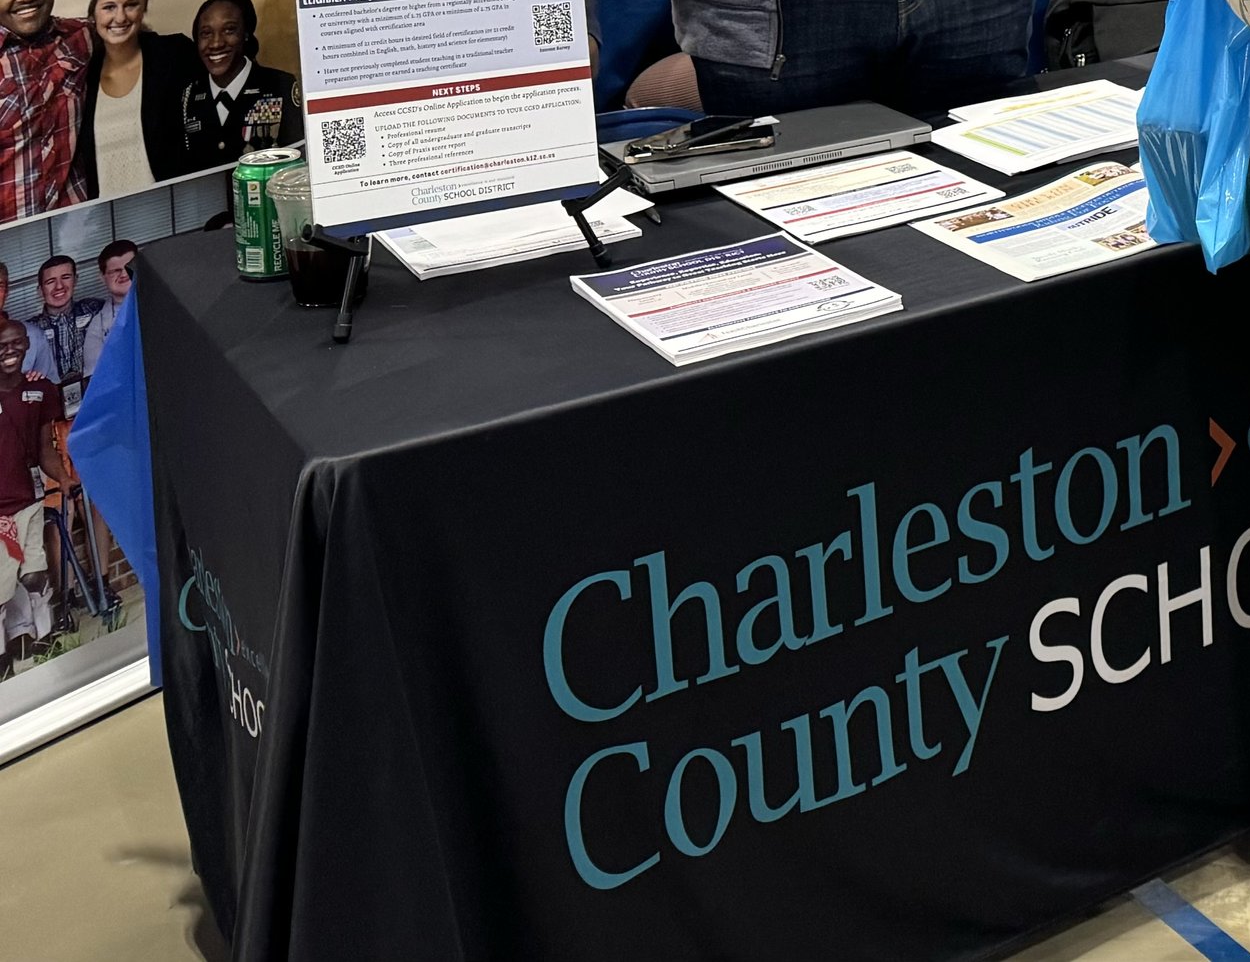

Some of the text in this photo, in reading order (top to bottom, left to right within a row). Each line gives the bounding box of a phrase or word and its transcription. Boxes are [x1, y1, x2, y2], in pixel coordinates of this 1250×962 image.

[432, 83, 480, 96] NEXT STEPS
[373, 110, 396, 118] Access
[423, 102, 445, 111] Online
[446, 98, 483, 109] Application
[491, 94, 510, 103] begin
[510, 92, 521, 100] the
[521, 89, 556, 99] application
[374, 122, 402, 132] UPLOAD
[402, 120, 415, 128] THE
[417, 115, 455, 126] FOLLOWING
[456, 110, 496, 121] DOCUMENTS
[506, 106, 523, 114] YOUR
[523, 104, 540, 112] CCSD
[387, 128, 423, 139] Professional
[387, 141, 403, 149] Copy
[419, 133, 462, 144] undergraduate
[463, 130, 474, 138] and
[475, 128, 500, 137] graduate
[501, 123, 531, 132] transcripts
[447, 141, 466, 149] report
[407, 152, 443, 165] professional
[444, 149, 474, 158] references
[369, 178, 389, 186] learn
[411, 170, 439, 179] contact
[410, 183, 457, 196] Charleston
[411, 181, 515, 206] County SCHOOL DISTRICT
[273, 235, 283, 272] RECYCLE
[542, 423, 1192, 722] Charleston
[564, 635, 1010, 890] County
